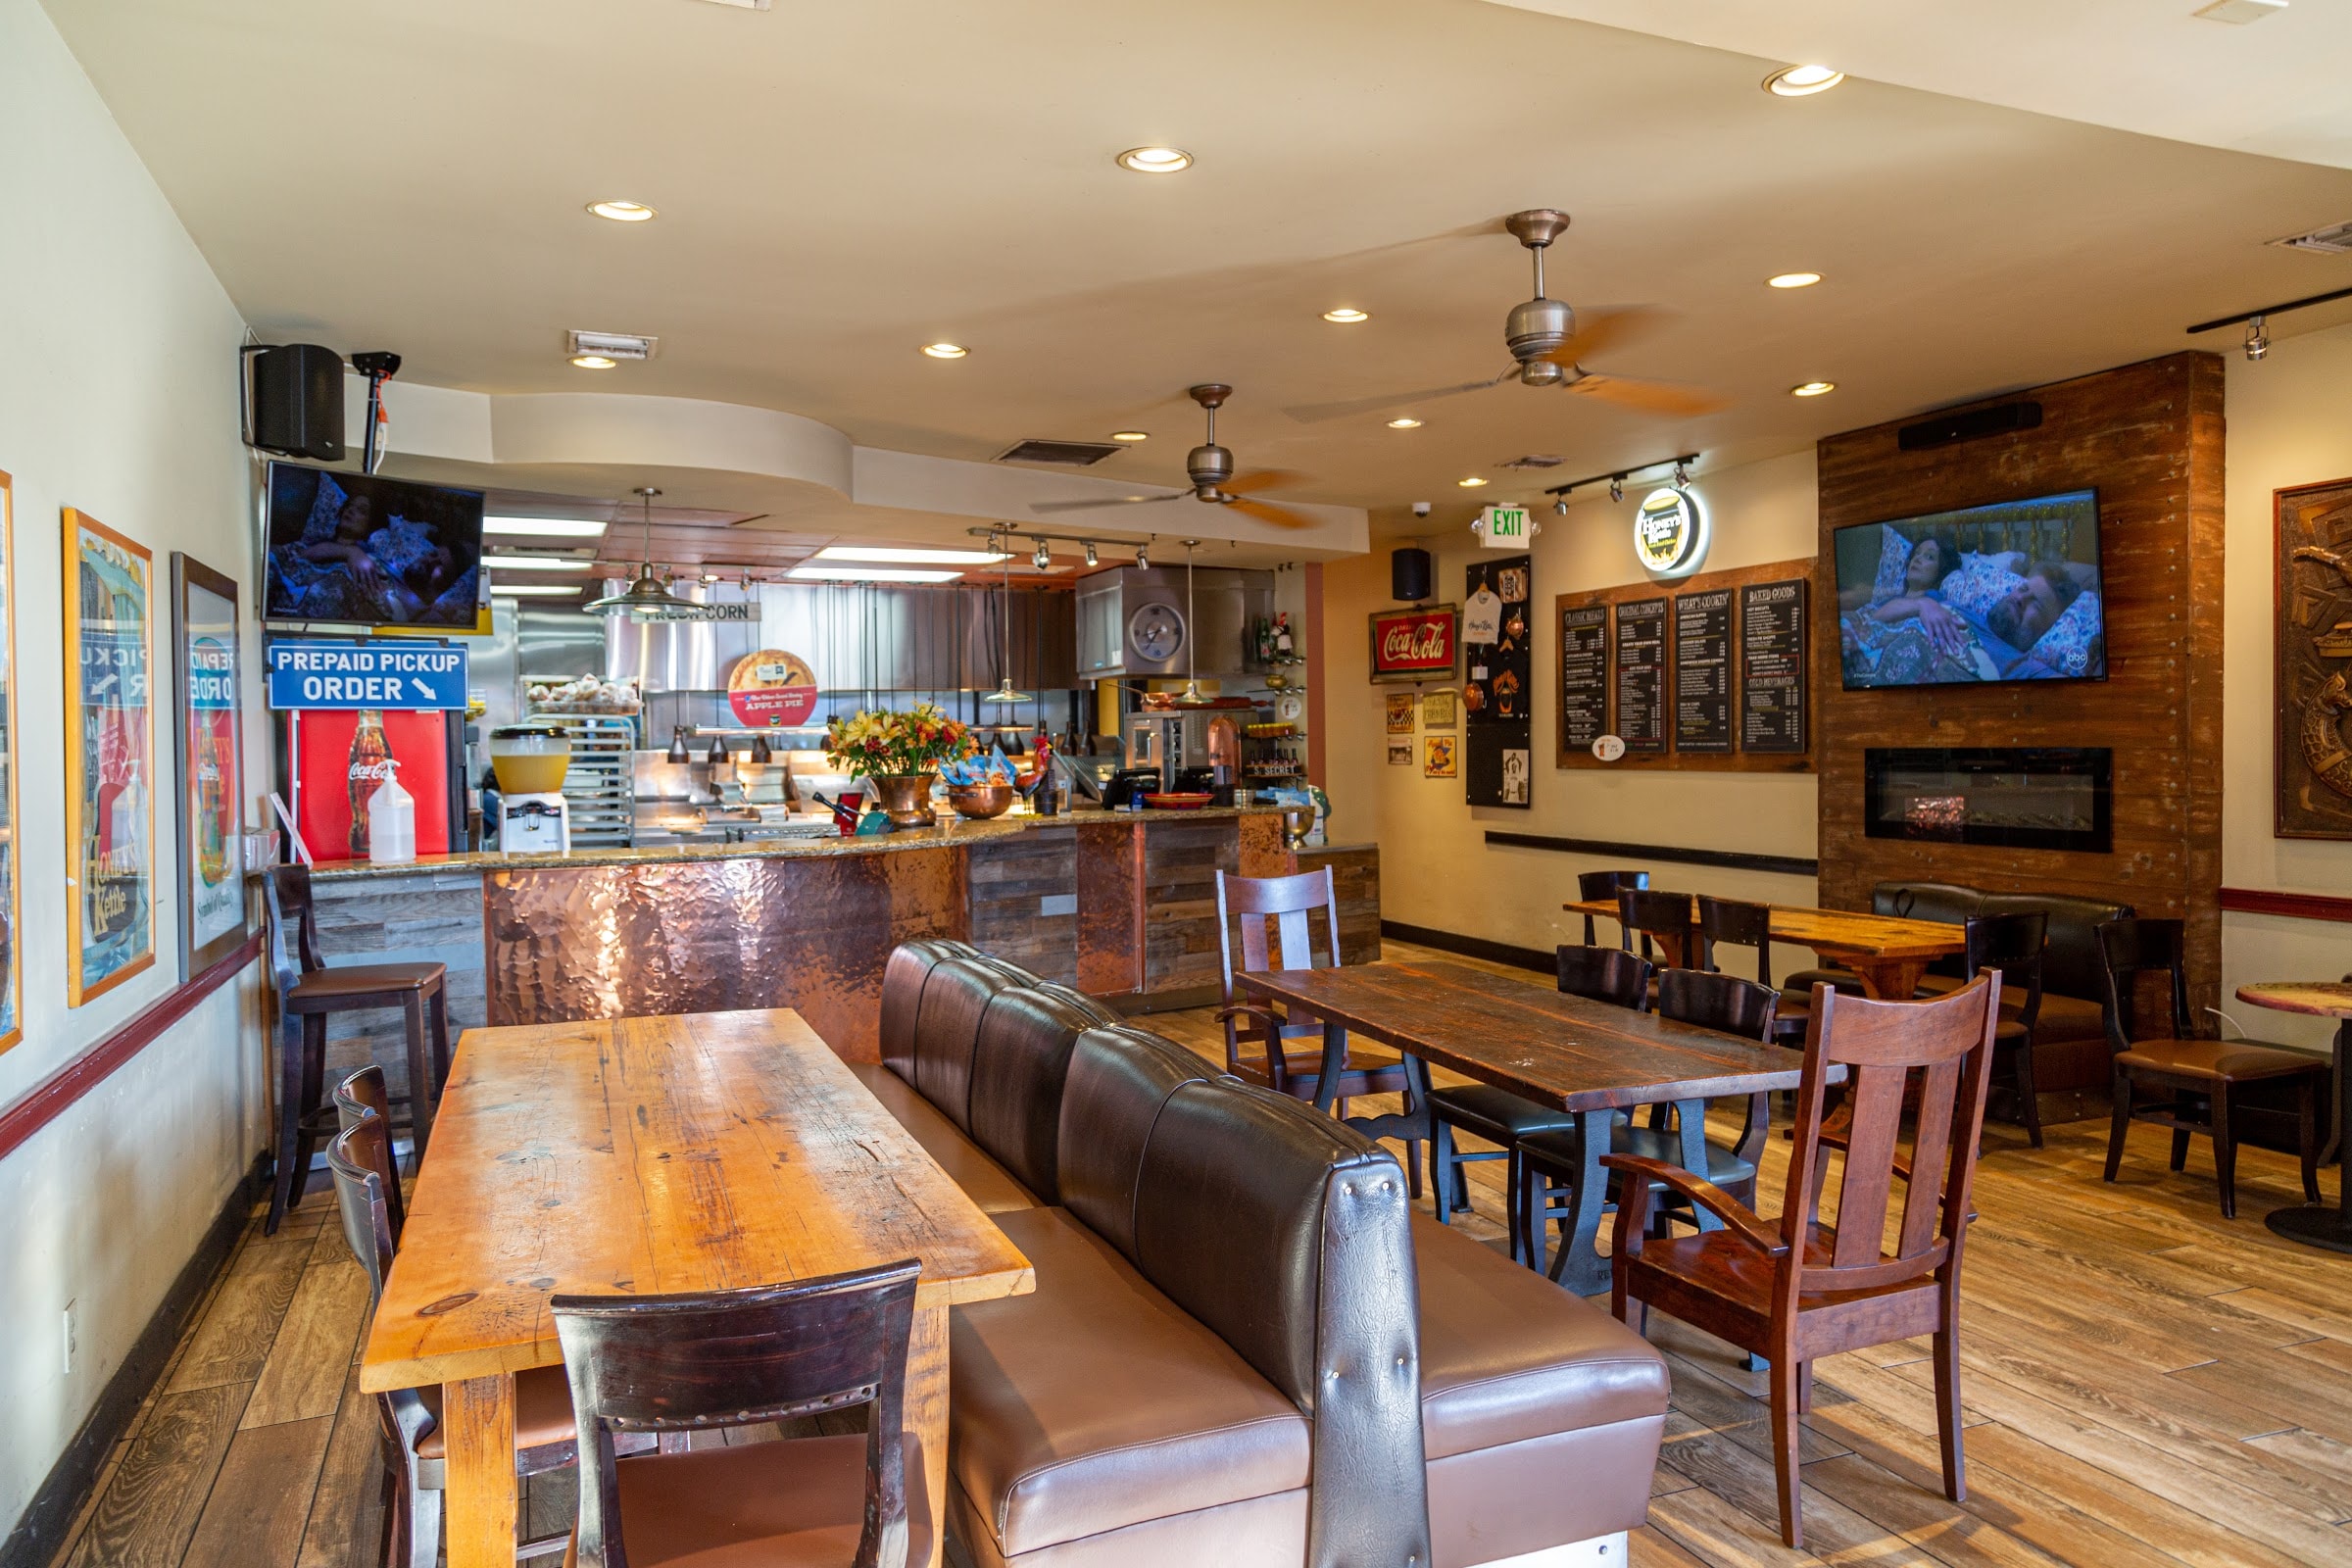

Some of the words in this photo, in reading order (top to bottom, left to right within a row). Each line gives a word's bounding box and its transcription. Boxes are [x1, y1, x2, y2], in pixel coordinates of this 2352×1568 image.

[1494, 510, 1524, 536] EXIT
[1749, 589, 1771, 602] BAKED
[1772, 586, 1795, 600] GOODS
[1678, 597, 1702, 611] WHAT'S
[706, 605, 749, 619] CORN
[277, 652, 374, 671] PREPAID
[380, 654, 460, 672] PICKUP
[2068, 653, 2086, 663] abc
[303, 676, 403, 701] ORDER
[746, 701, 783, 710] APPLE
[1265, 765, 1295, 775] SECRET
[94, 885, 126, 936] Kettle
